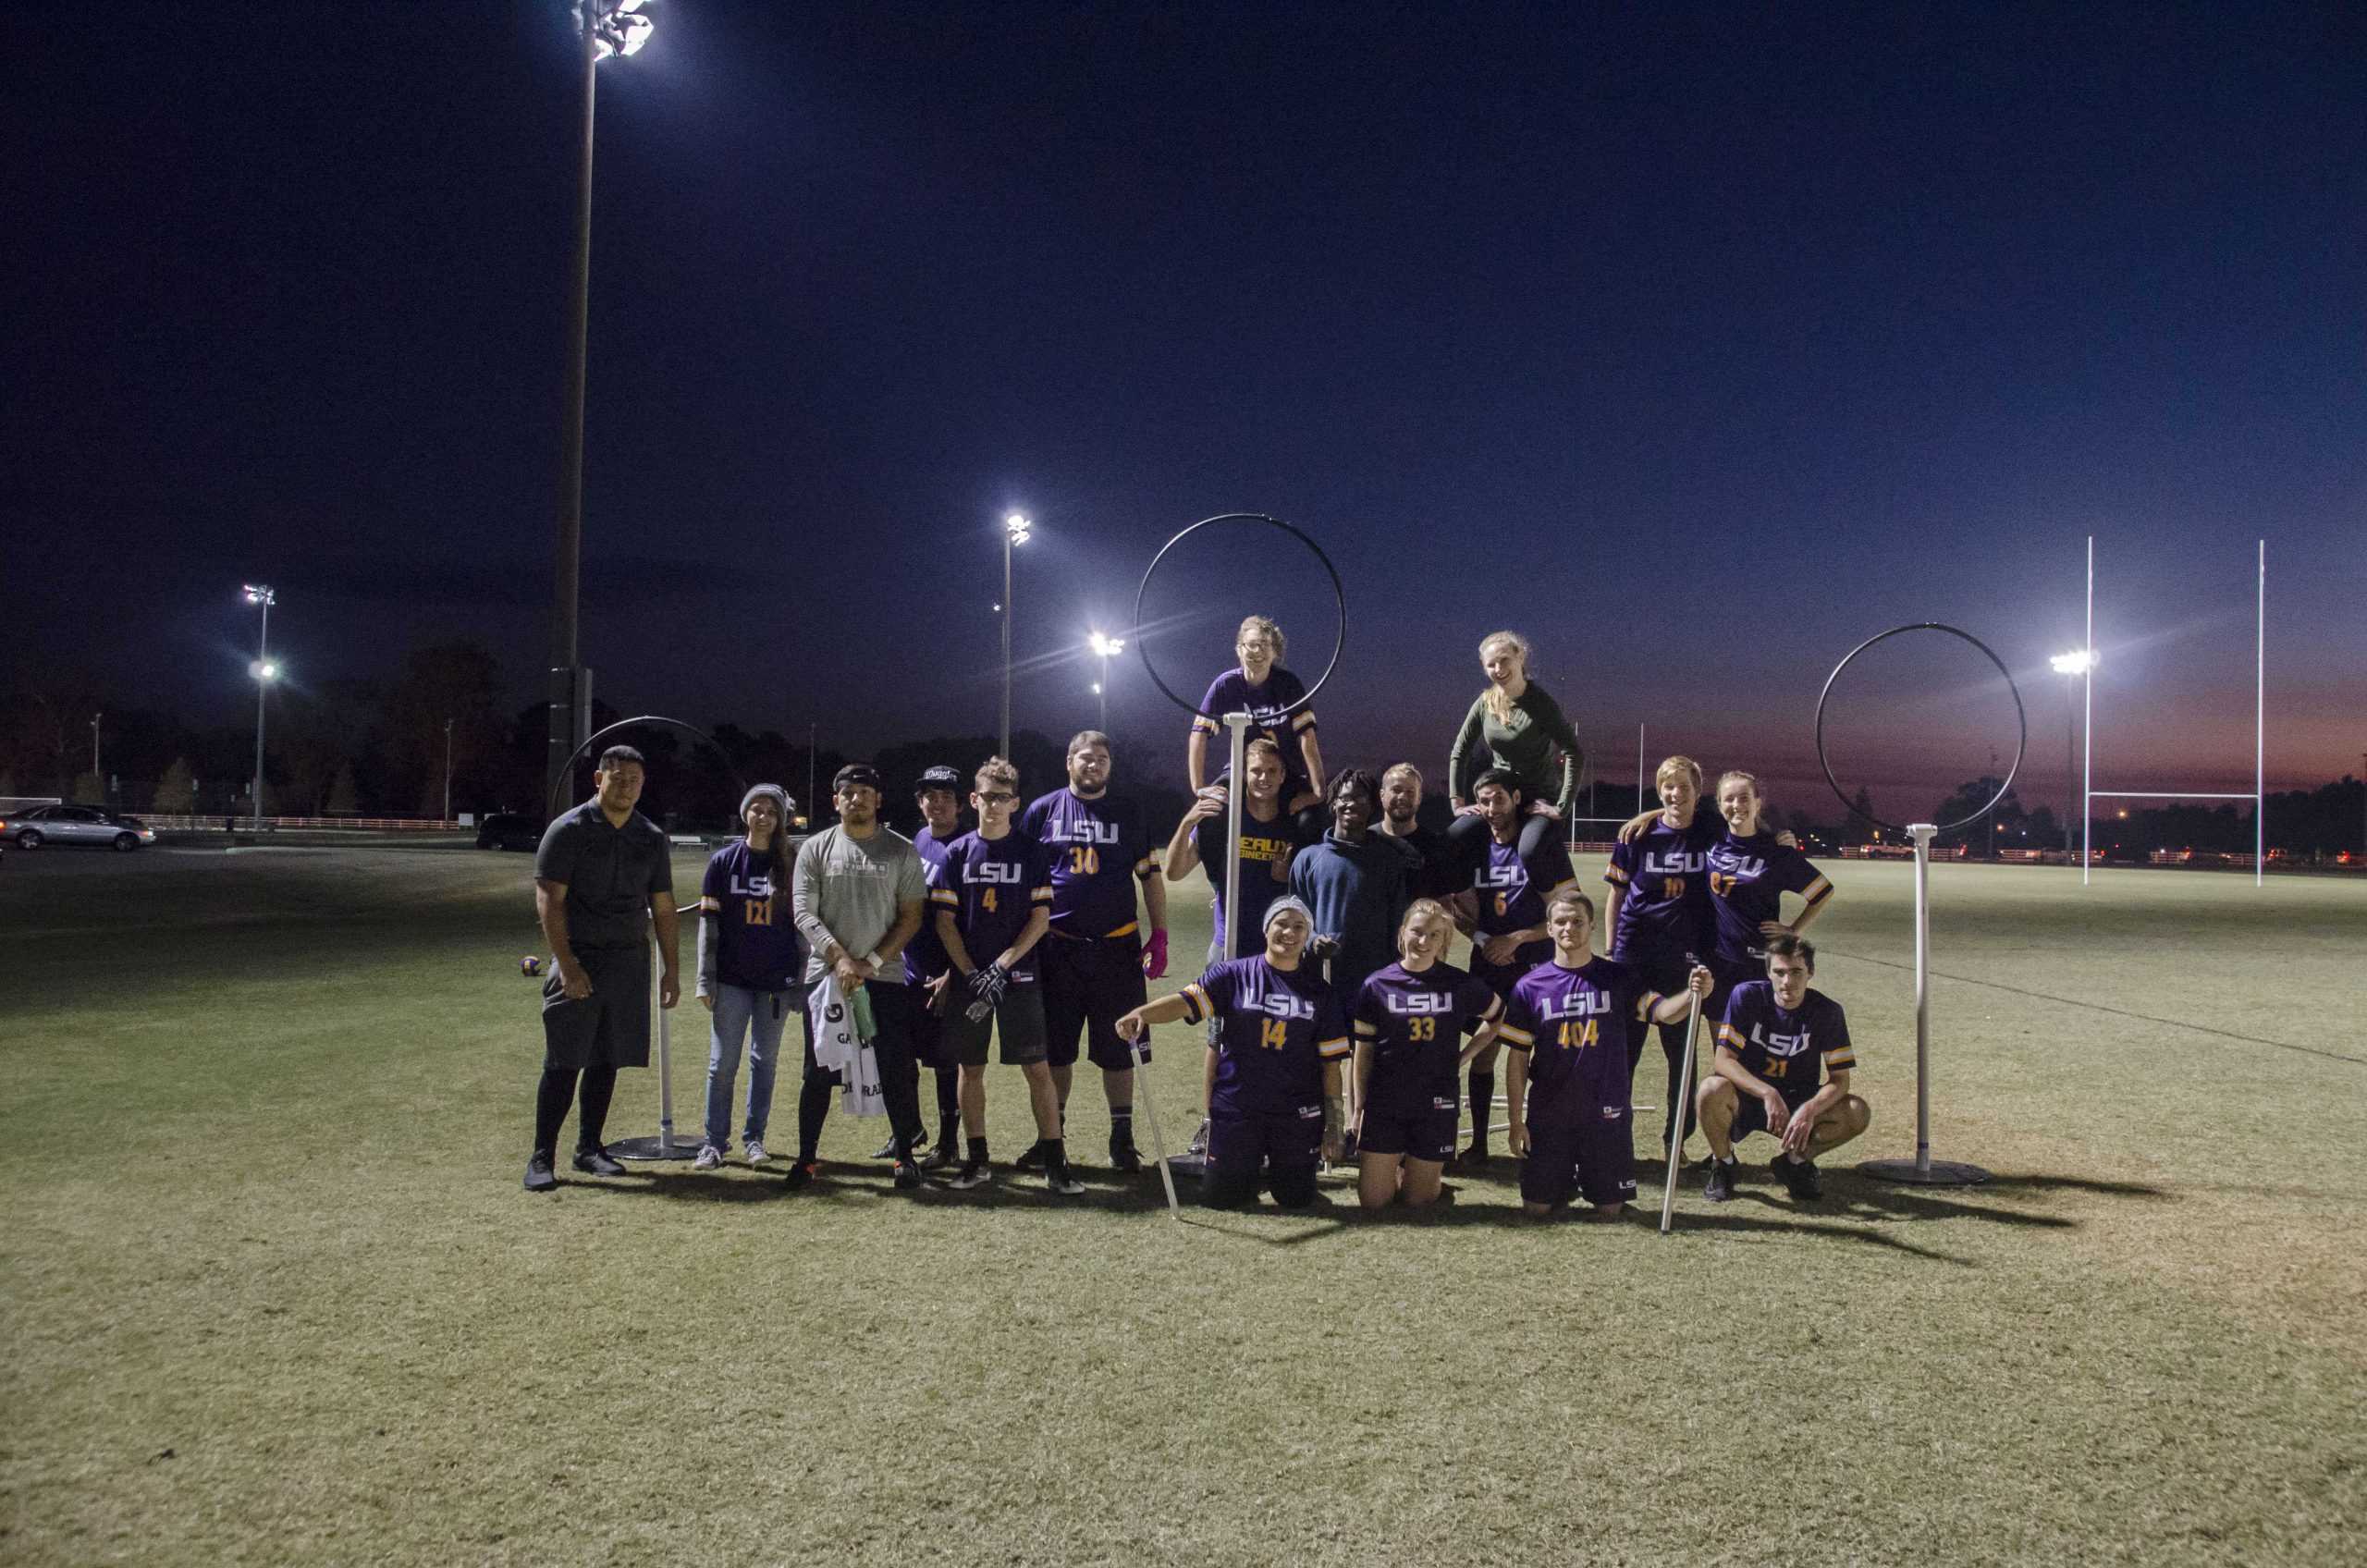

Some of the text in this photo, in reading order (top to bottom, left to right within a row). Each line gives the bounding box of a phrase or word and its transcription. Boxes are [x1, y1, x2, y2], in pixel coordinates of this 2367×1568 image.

[1051, 819, 1119, 843] LSU
[963, 862, 1022, 885] LSU
[1069, 846, 1099, 875] 30
[1645, 851, 1705, 873] LSU
[1474, 864, 1529, 888] LSU
[982, 886, 999, 913] 4
[1243, 986, 1315, 1020] LSU
[1387, 991, 1453, 1013] LSU
[1541, 990, 1611, 1021] LSU
[1261, 1017, 1287, 1050] 14
[1408, 1017, 1436, 1042] 33
[1557, 1019, 1599, 1049] 404
[1750, 1021, 1811, 1058] LSU
